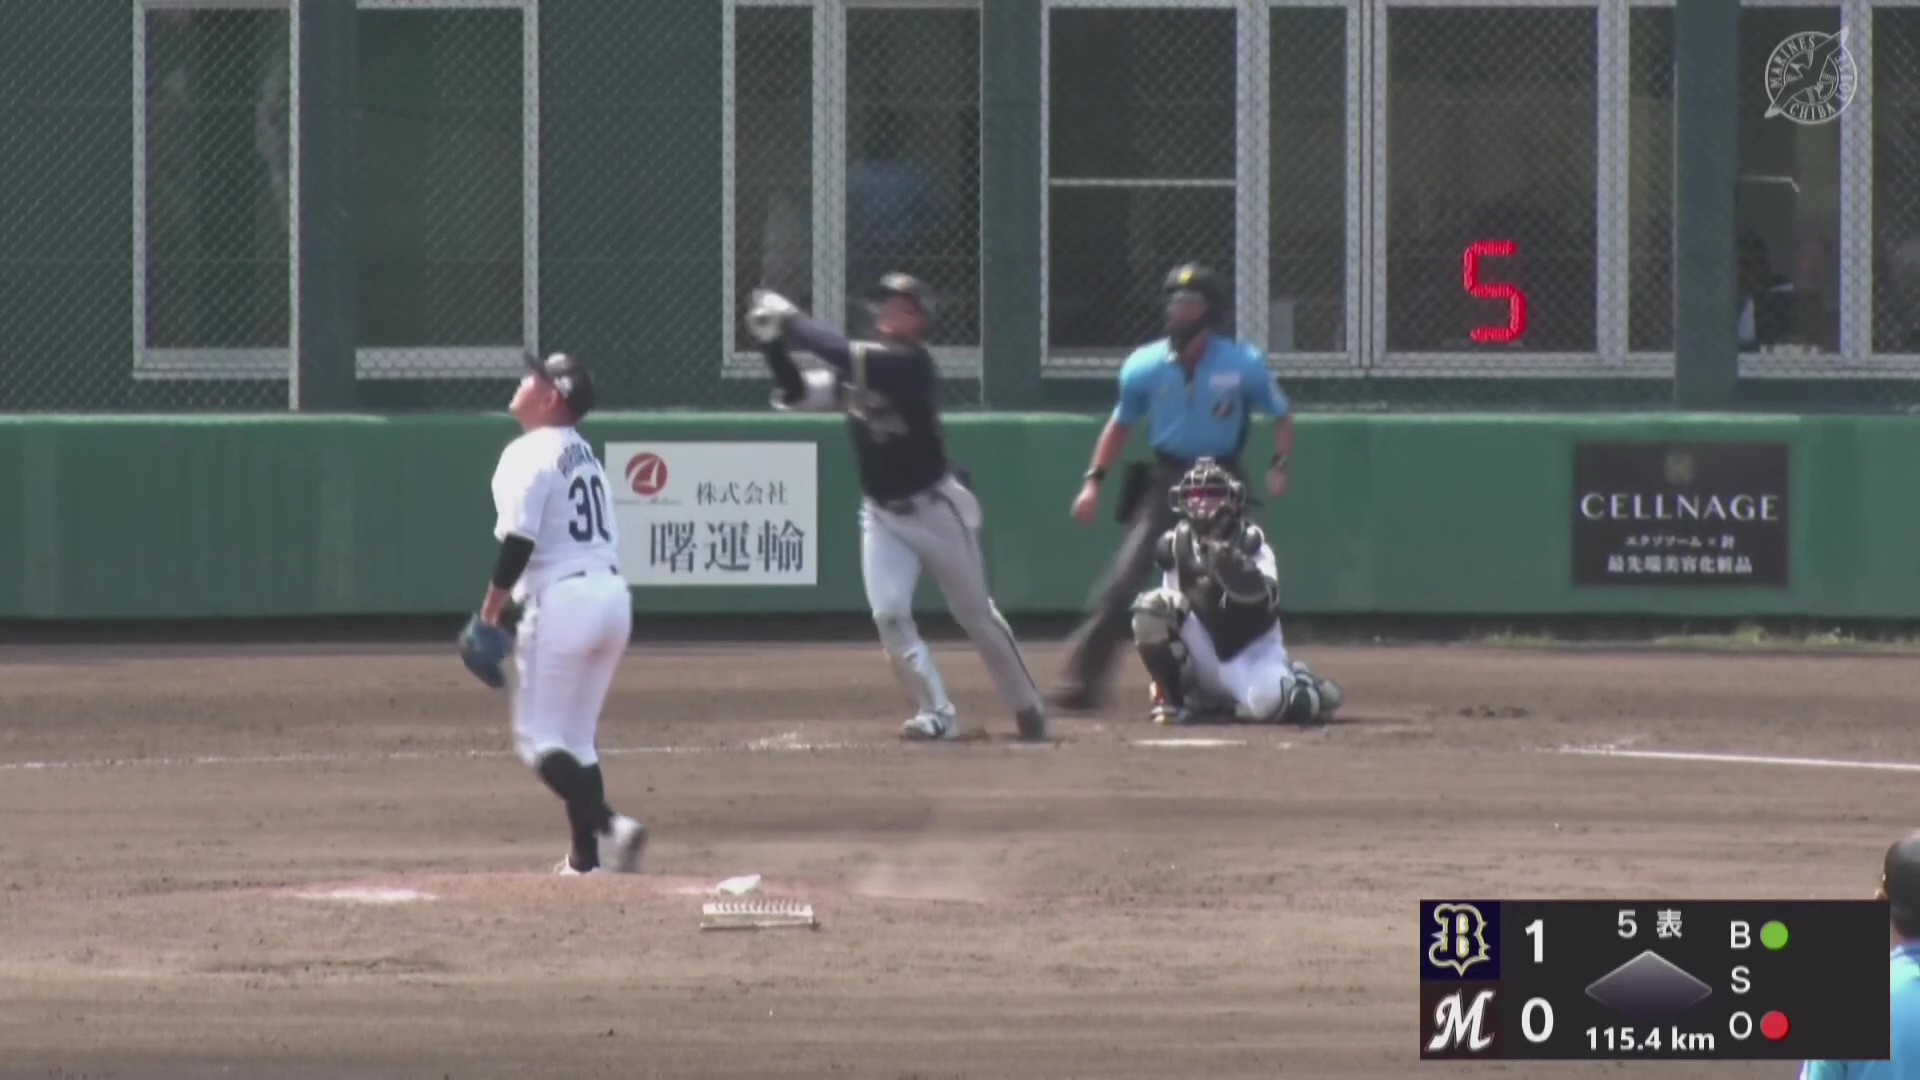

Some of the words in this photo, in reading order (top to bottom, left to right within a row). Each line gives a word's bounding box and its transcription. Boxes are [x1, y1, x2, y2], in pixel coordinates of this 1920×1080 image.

[1463, 241, 1526, 342] 5
[697, 481, 788, 505] 株式会社
[1580, 493, 1778, 520] CELLNAGE
[651, 520, 805, 573] 曙運輸
